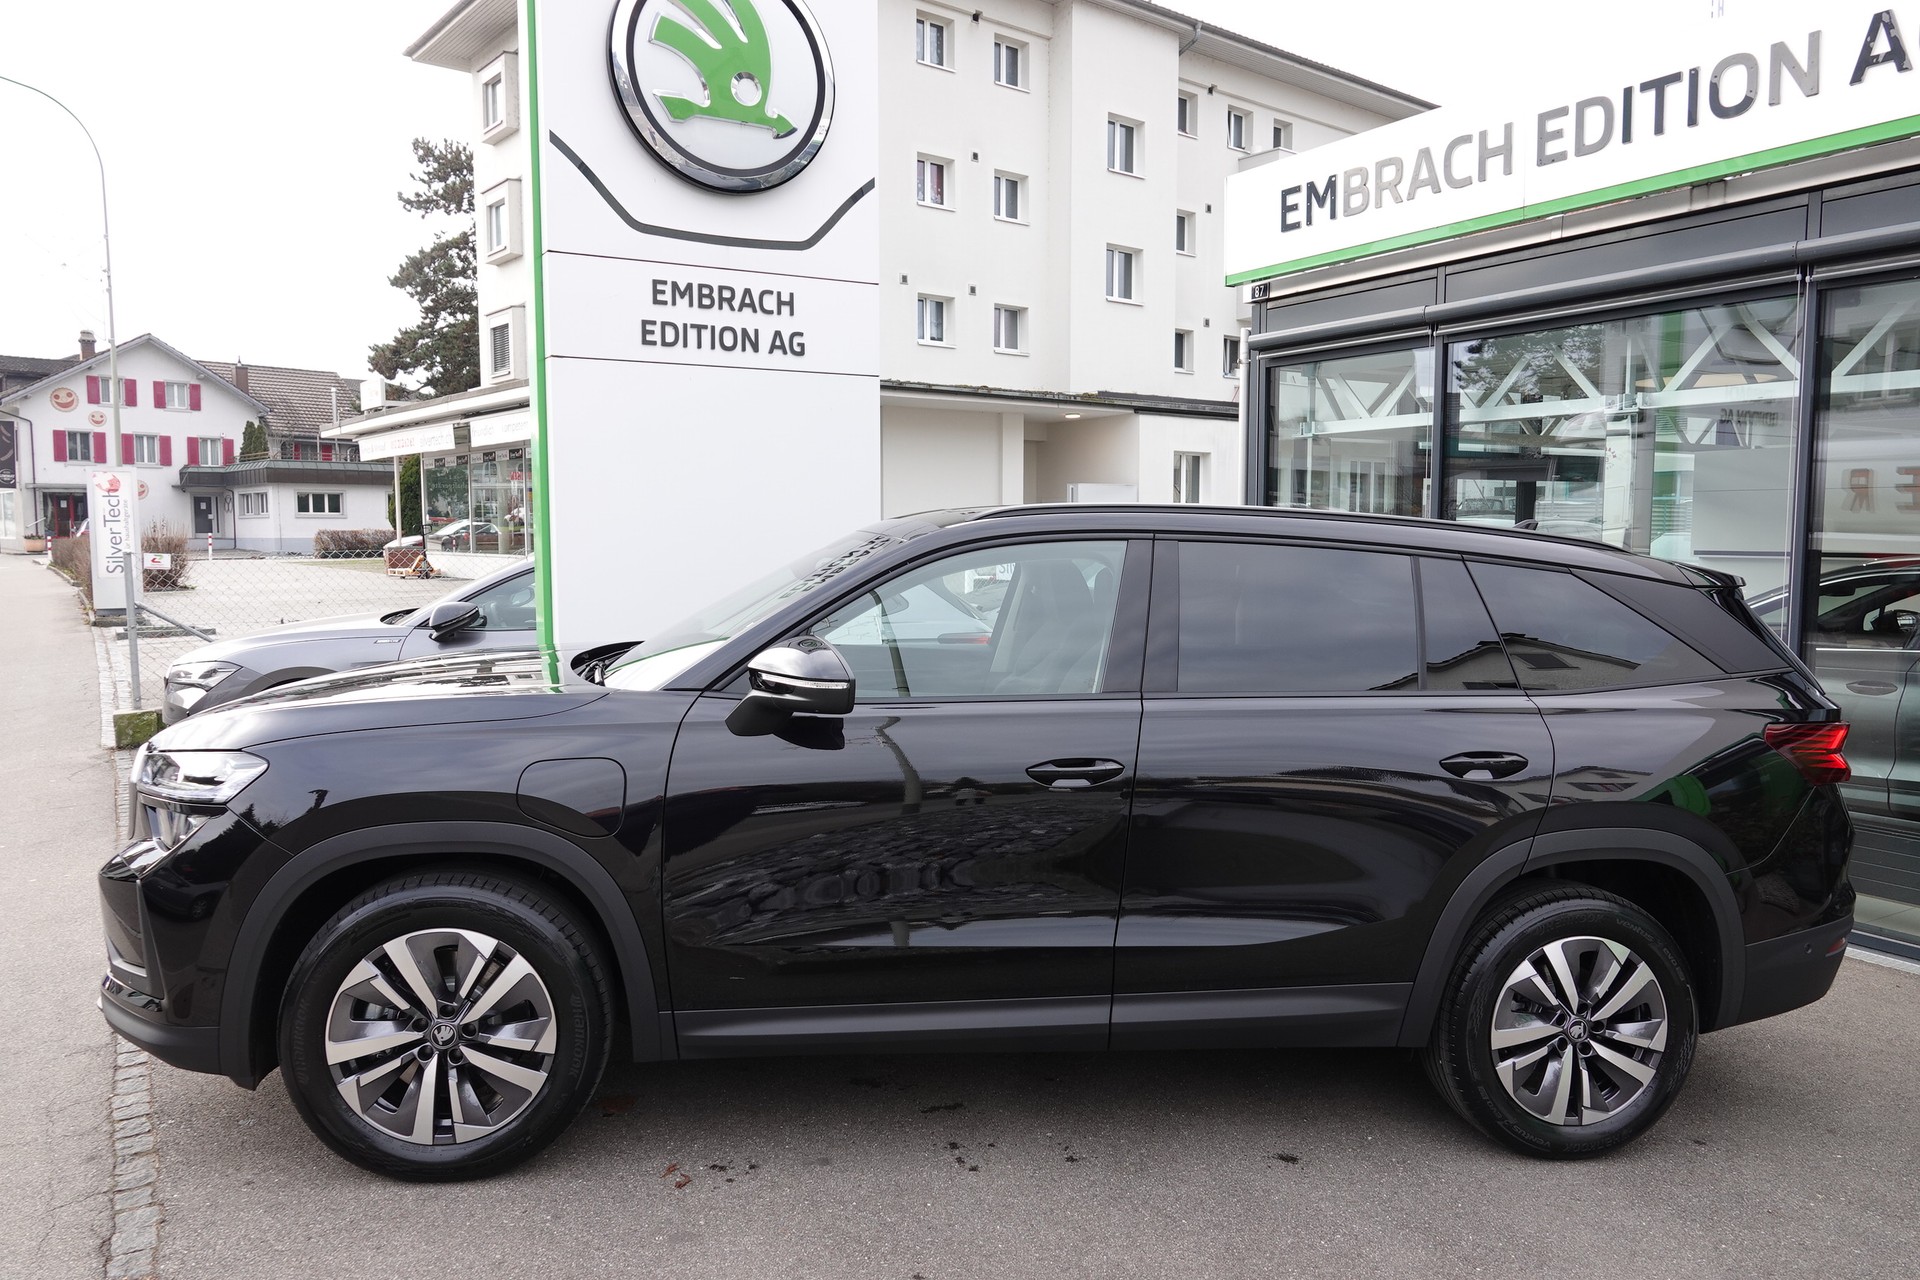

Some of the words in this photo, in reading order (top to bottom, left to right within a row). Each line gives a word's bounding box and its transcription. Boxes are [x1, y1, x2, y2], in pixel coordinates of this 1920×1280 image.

[1280, 121, 1514, 233] EMBRACH
[1536, 29, 1822, 167] EDITION
[1849, 8, 1920, 87] A
[651, 278, 796, 317] EMBRACH
[1254, 285, 1265, 298] 87
[640, 318, 760, 354] EDITION
[767, 329, 806, 357] AG
